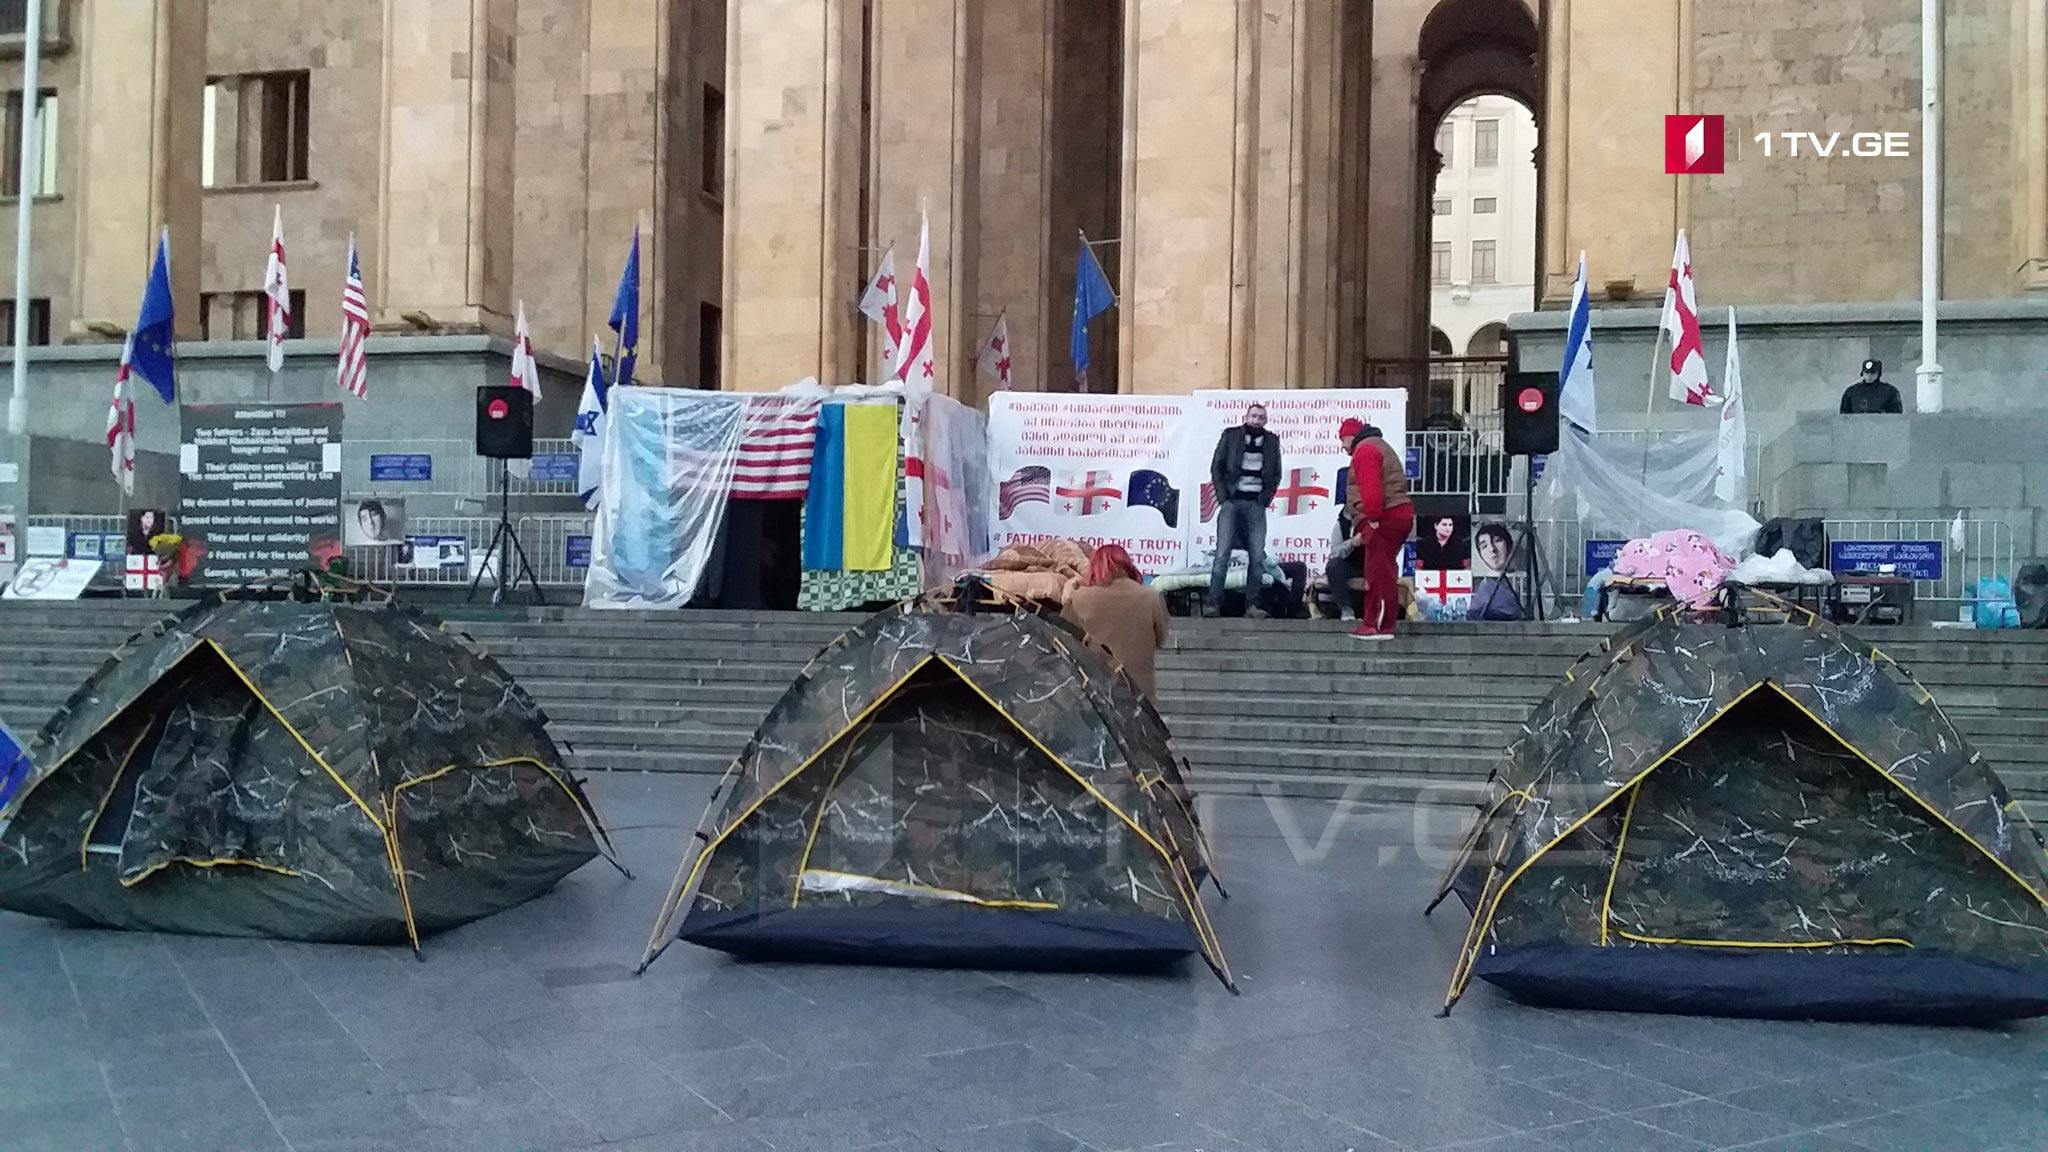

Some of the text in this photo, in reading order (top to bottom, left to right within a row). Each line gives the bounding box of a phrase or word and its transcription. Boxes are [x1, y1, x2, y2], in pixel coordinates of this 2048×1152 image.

[1140, 539, 1182, 550] TRUTH
[1285, 537, 1313, 549] FOR
[1128, 553, 1175, 566] STORY!
